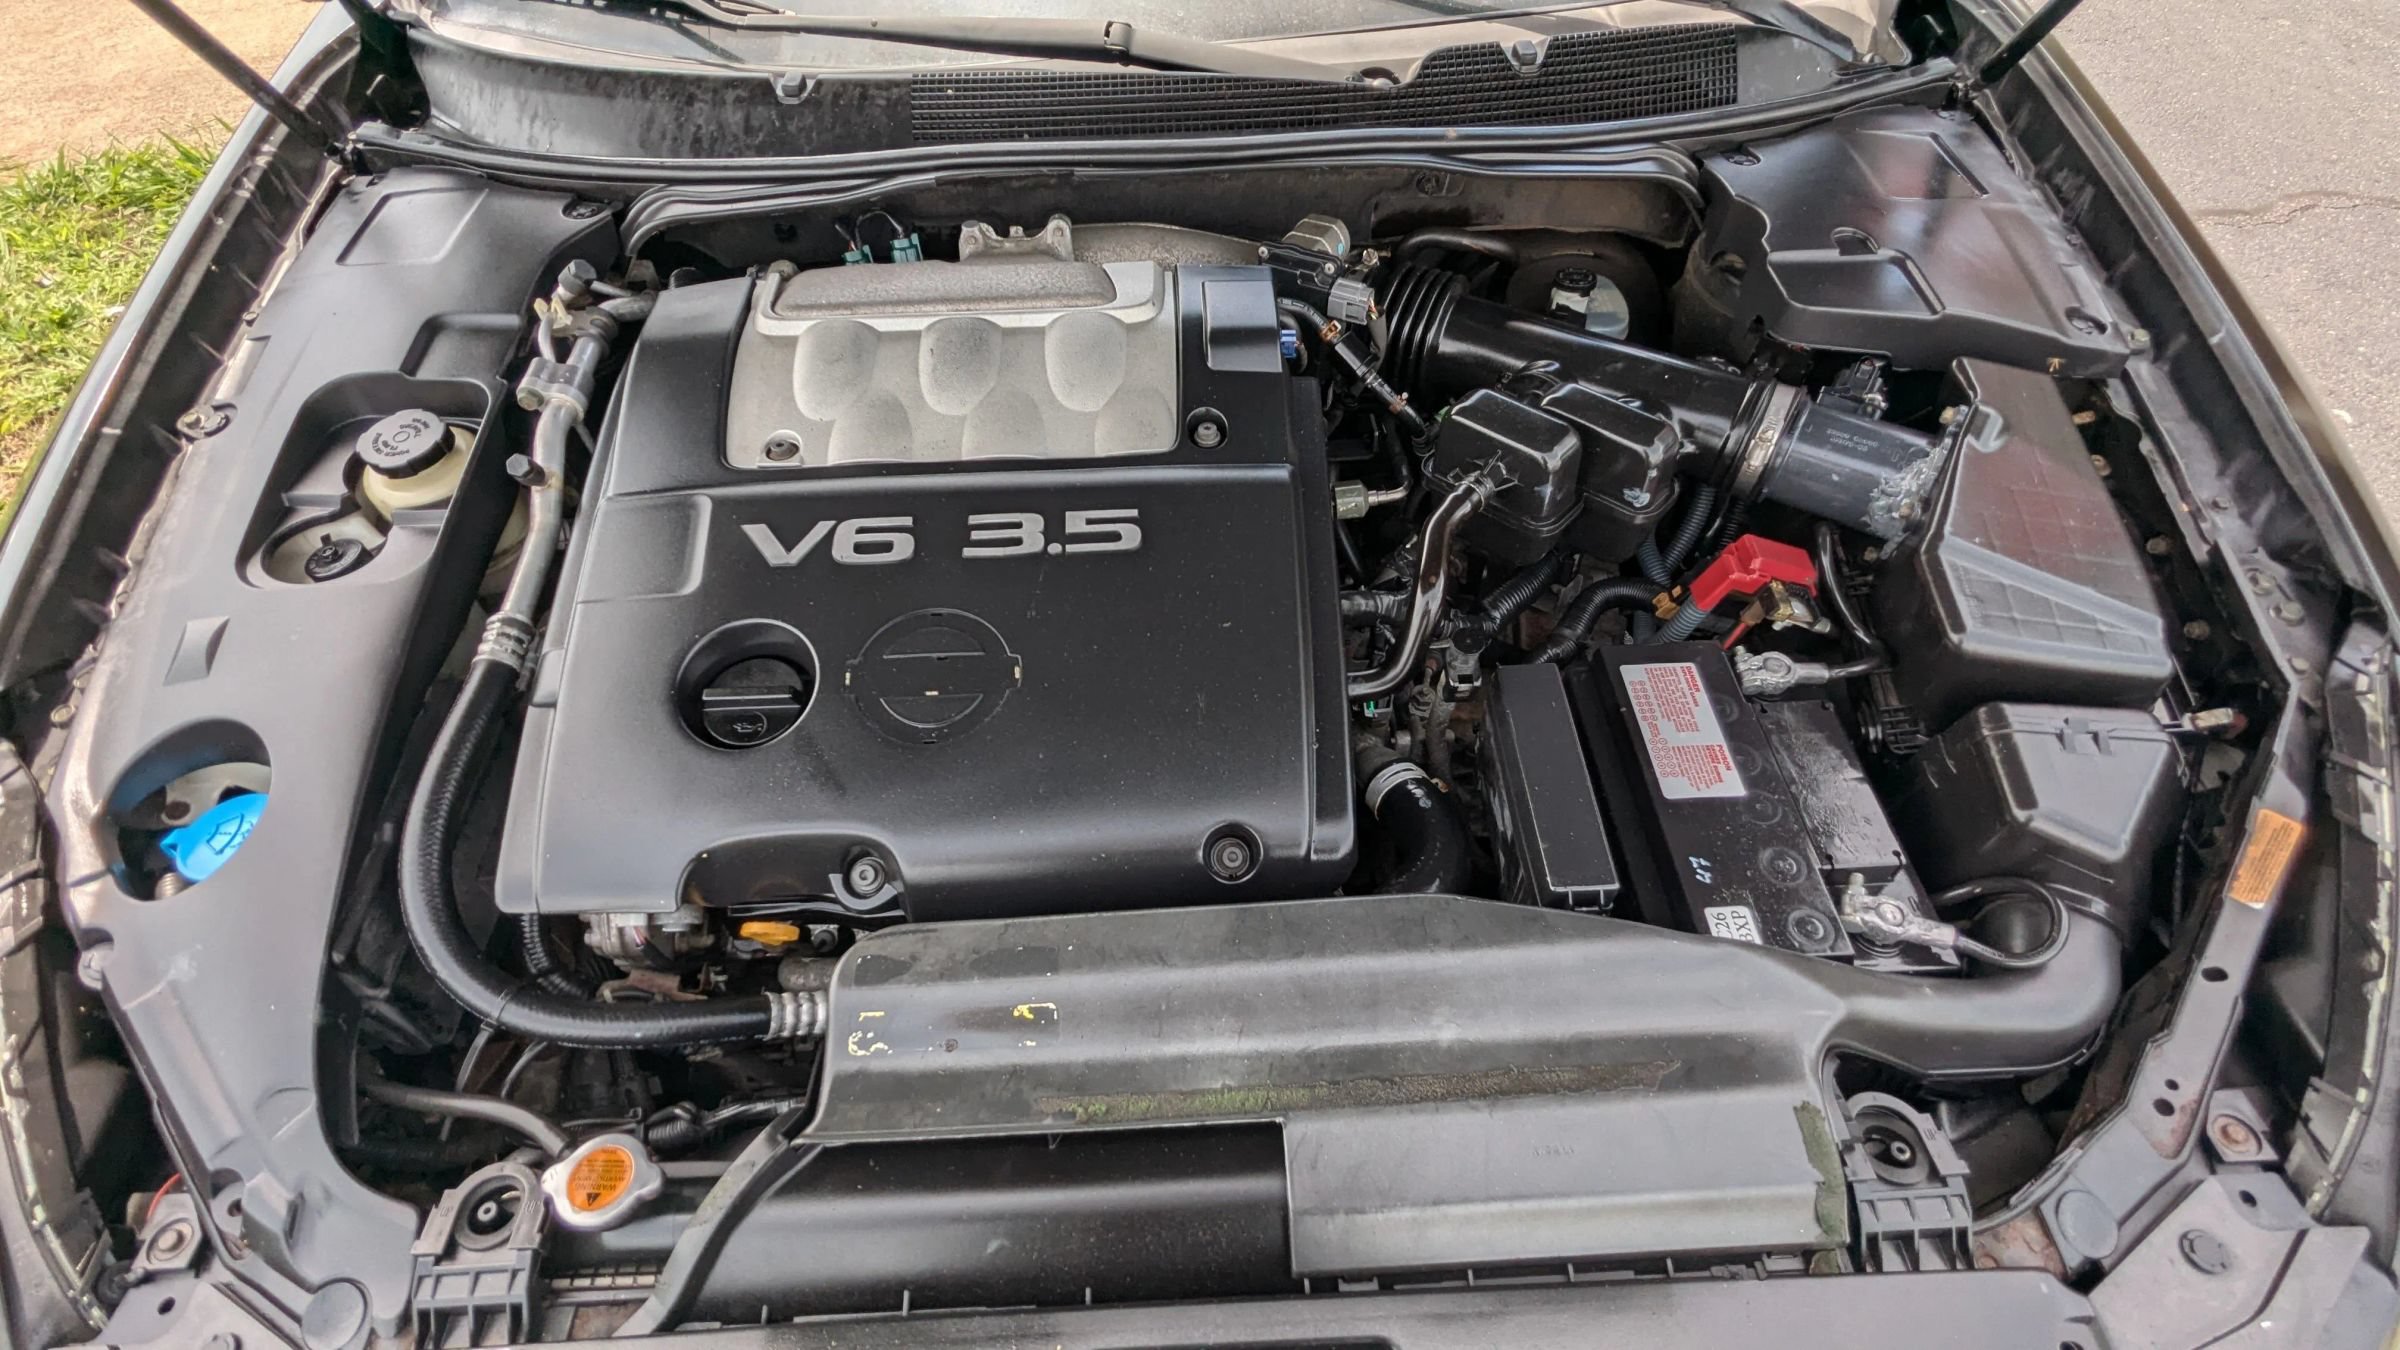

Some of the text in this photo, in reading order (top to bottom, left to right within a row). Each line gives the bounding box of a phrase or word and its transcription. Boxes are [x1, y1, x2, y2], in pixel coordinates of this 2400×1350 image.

[740, 509, 1142, 568] V6 3.5
[1685, 665, 1701, 693] DANGER
[1715, 744, 1732, 771] POISON
